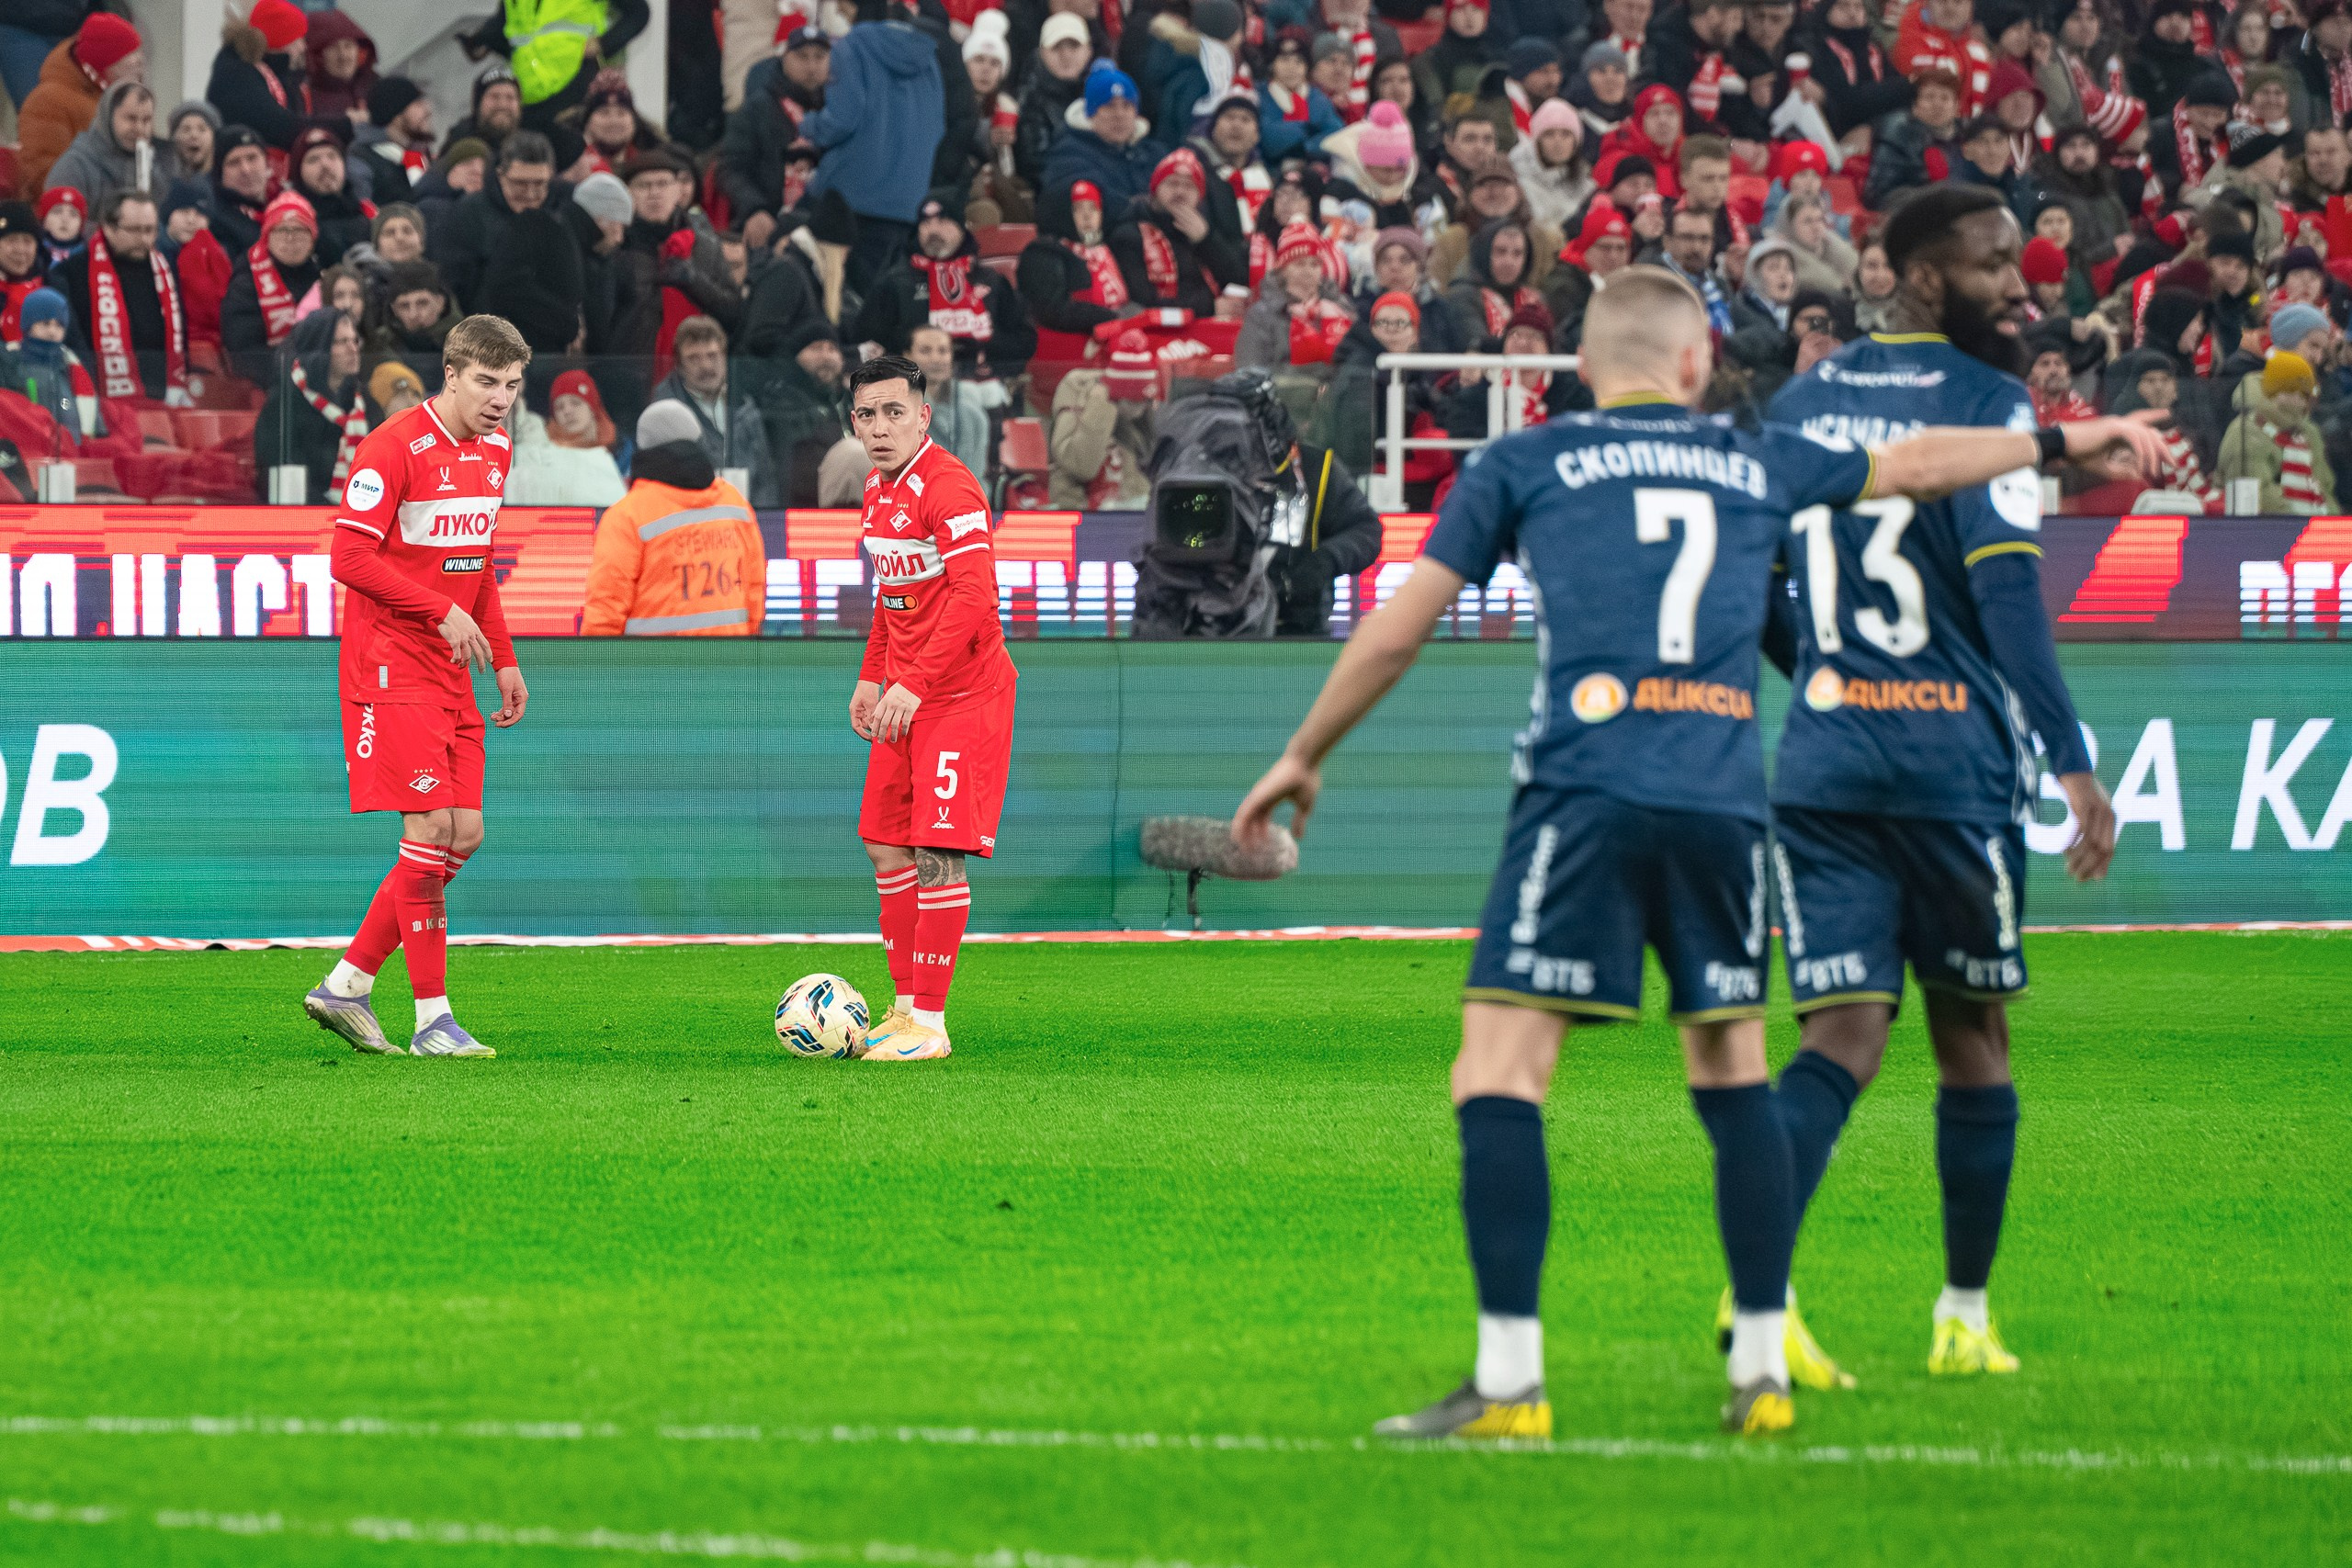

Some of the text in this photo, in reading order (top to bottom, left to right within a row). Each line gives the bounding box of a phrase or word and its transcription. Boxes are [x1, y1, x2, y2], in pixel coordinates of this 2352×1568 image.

[1555, 440, 1768, 501] СКОПИНЦЕВ
[444, 558, 484, 570] WINLINE
[1633, 487, 1717, 664] 7
[1791, 494, 1928, 657] 13
[0, 724, 119, 866] В
[933, 750, 961, 800] 5
[2230, 718, 2352, 851] К
